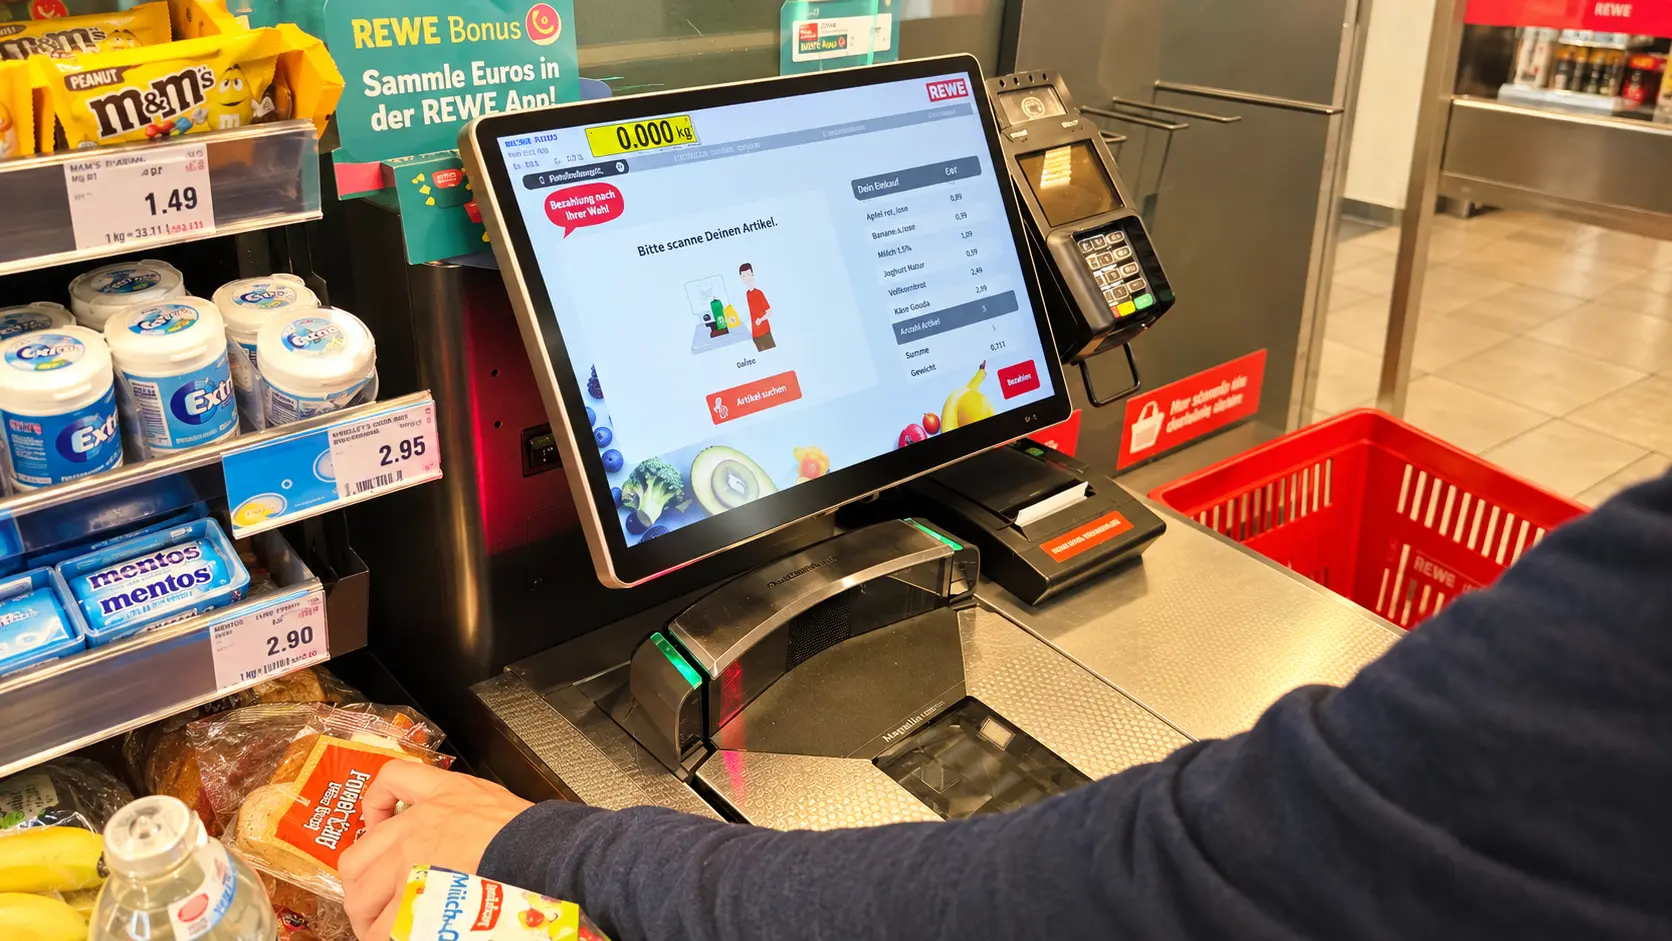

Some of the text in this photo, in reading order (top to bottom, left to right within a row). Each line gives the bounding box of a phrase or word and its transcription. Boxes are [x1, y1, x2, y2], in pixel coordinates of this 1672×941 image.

[351, 15, 522, 49] REWE Bonus
[69, 68, 118, 90] PEANUT
[362, 56, 560, 97] Sammle Euros in
[929, 80, 967, 100] REWE
[370, 104, 415, 132] der
[421, 91, 499, 125] REWE
[616, 120, 692, 150] 0.000 kg
[145, 186, 198, 216] 1.49
[550, 189, 616, 210] Bezahlung nach
[637, 216, 778, 257] Bitte scanne Deinen Artikel.
[910, 363, 937, 377] Gewicht
[185, 375, 234, 416] Extr
[71, 406, 118, 454] Ext
[379, 435, 426, 467] 2.95
[88, 545, 201, 590] mentos
[1413, 555, 1457, 589] REWE
[99, 566, 212, 615] mentos
[266, 625, 314, 657] 2.90
